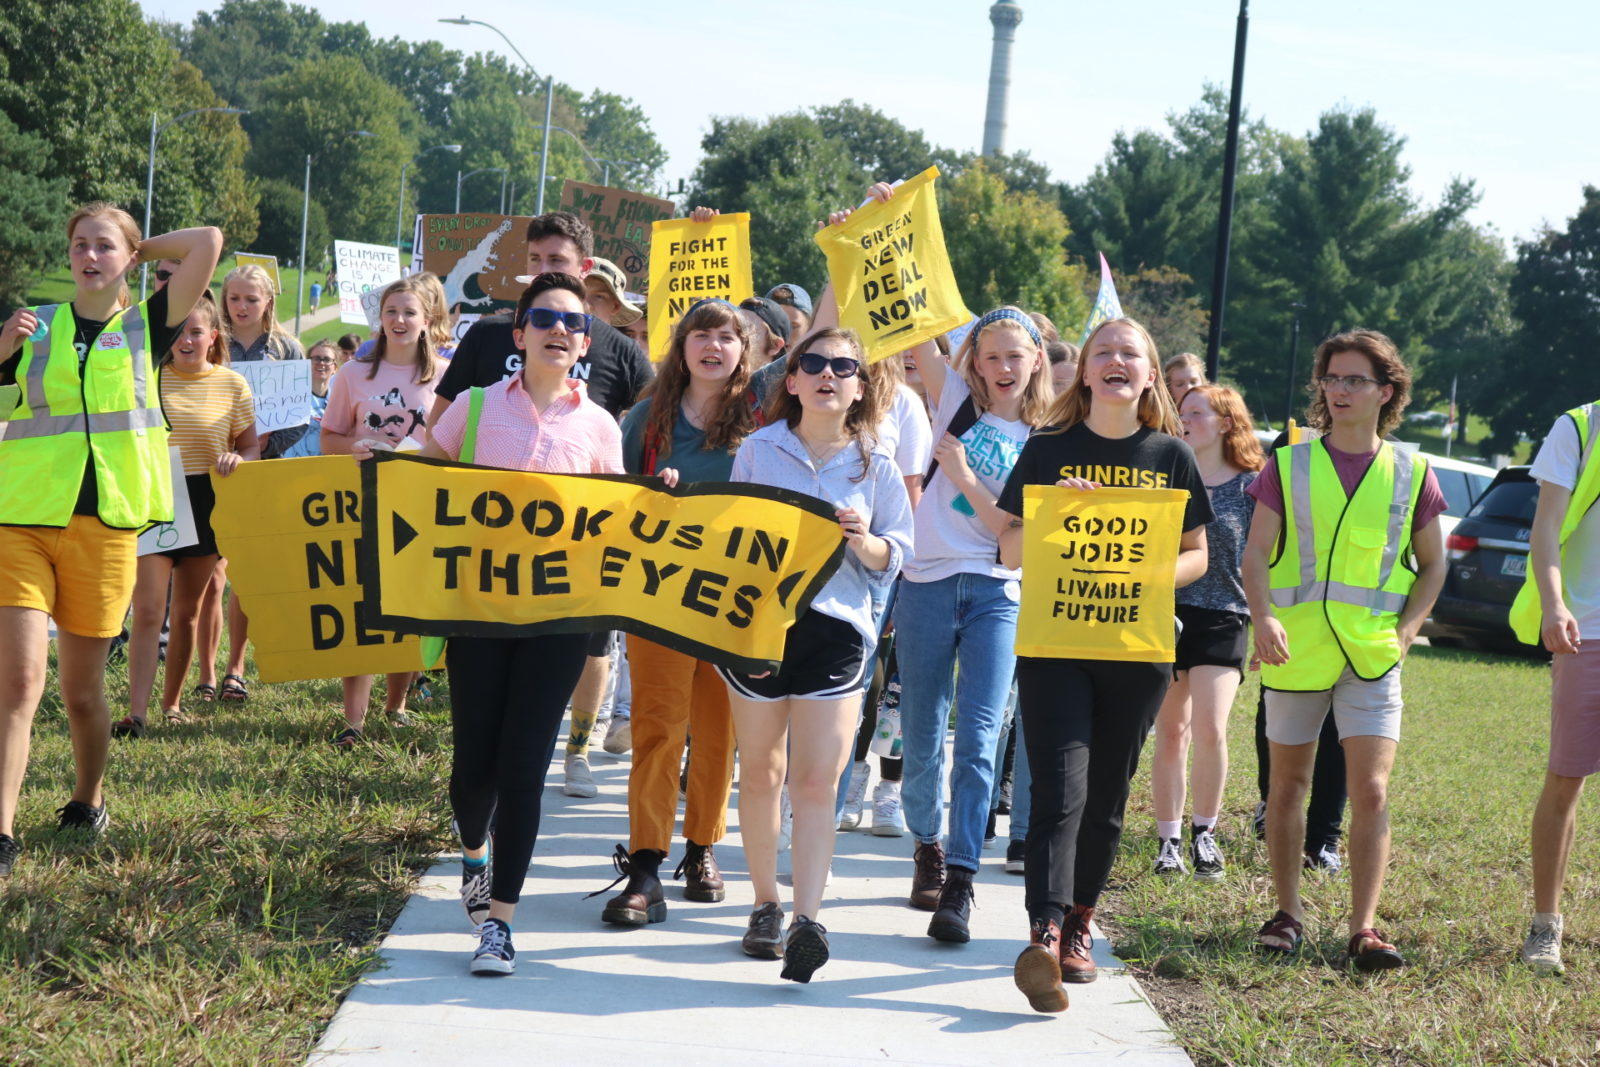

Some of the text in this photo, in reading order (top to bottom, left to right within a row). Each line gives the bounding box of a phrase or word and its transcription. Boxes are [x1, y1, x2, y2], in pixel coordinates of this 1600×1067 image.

[573, 187, 605, 213] WE
[429, 216, 461, 233] EVERY
[861, 211, 912, 249] GREEN
[339, 247, 396, 263] CLIMATE
[670, 237, 727, 256] FIGHT
[864, 233, 913, 276] NEW
[340, 258, 394, 273] CHANGE
[669, 257, 729, 272] FOR THE
[352, 270, 383, 284] IS A
[669, 274, 730, 292] GREEN
[863, 261, 923, 303] DEAL
[868, 287, 927, 330] NOW
[232, 362, 309, 396] ARTH
[1059, 465, 1169, 488] SUNRISE
[435, 488, 789, 573] LOOK US IN
[1064, 515, 1148, 536] GOOD
[1060, 541, 1145, 563] JOBS
[433, 546, 762, 628] THE EYES
[1057, 577, 1142, 599] LIVABLE
[1052, 601, 1139, 623] FUTURE
